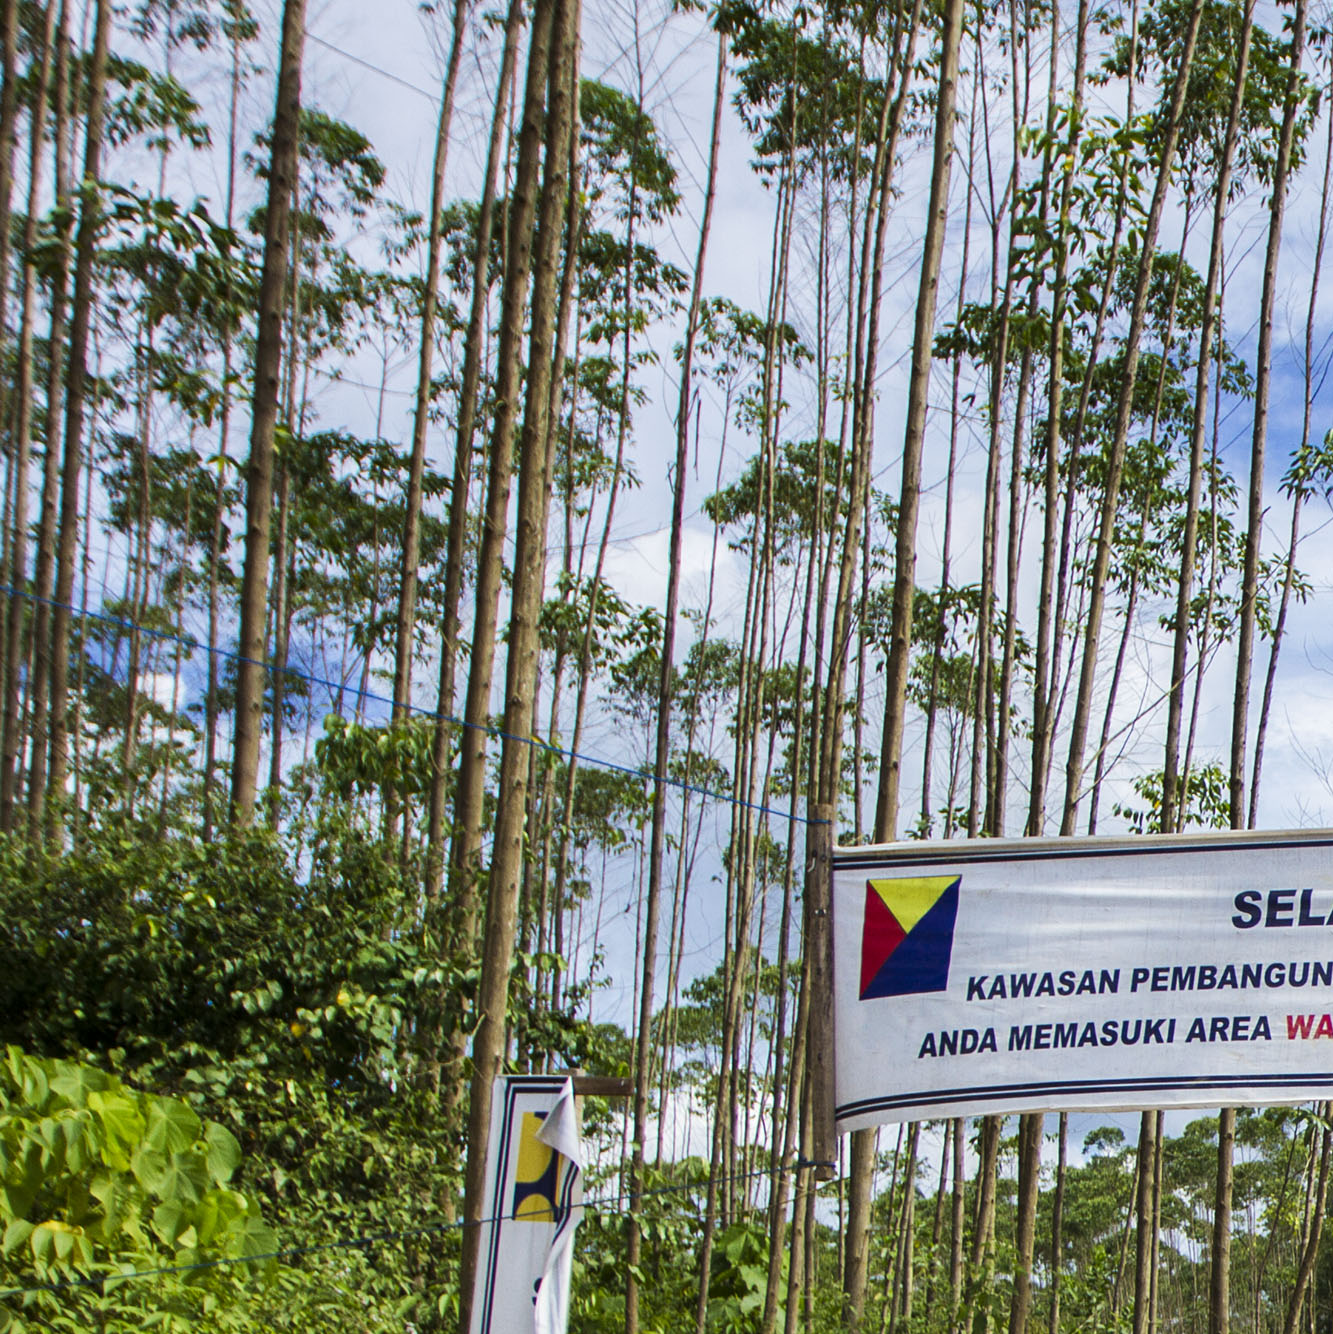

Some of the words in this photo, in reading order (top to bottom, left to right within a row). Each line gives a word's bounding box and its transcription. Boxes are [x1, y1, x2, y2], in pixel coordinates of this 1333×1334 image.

[966, 968, 1120, 1001] KAWASAN
[918, 1027, 997, 1059] ANDA
[1008, 1018, 1177, 1051] MEMASUKI
[1185, 1015, 1272, 1043] AREA
